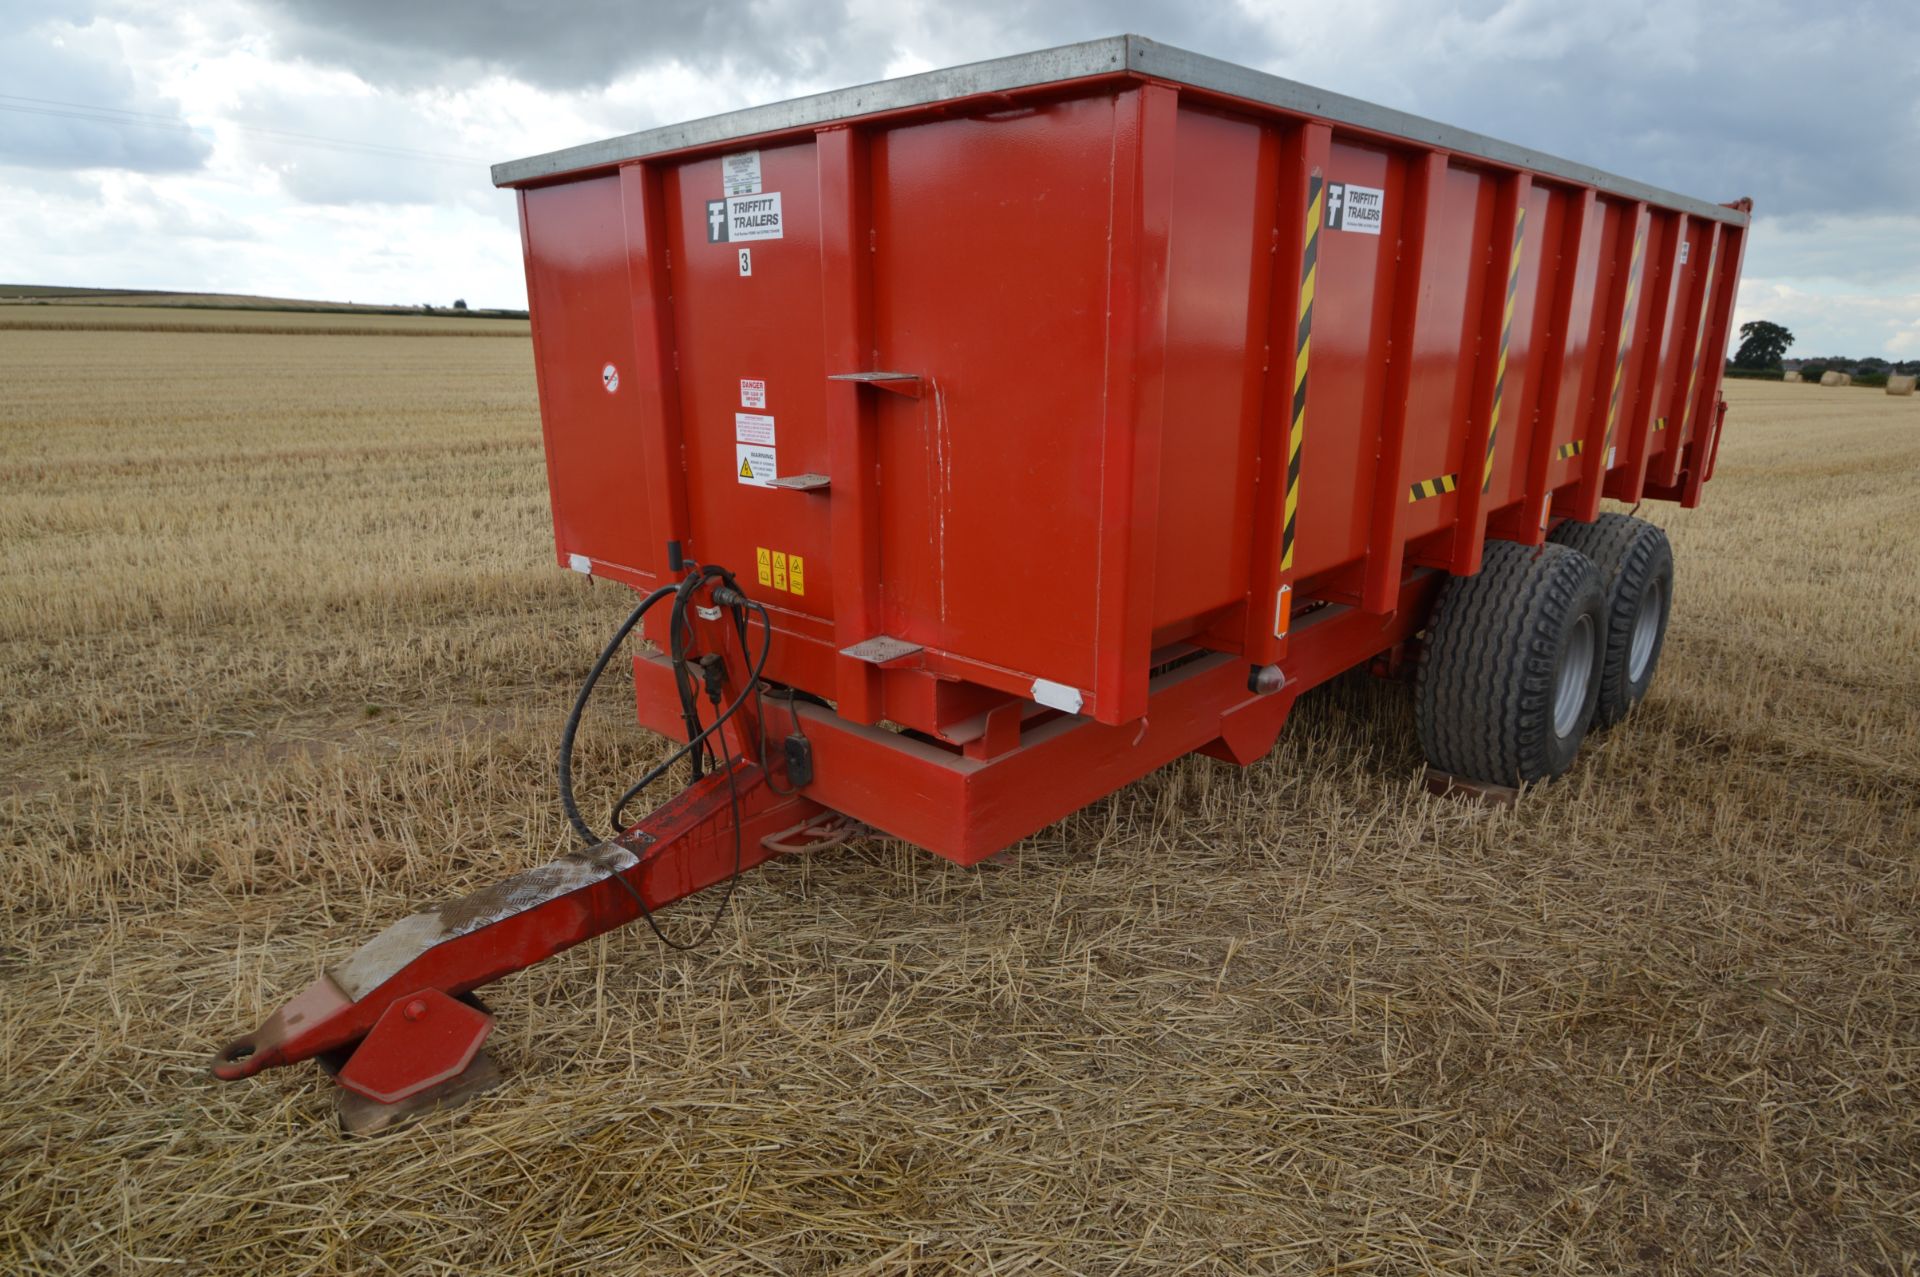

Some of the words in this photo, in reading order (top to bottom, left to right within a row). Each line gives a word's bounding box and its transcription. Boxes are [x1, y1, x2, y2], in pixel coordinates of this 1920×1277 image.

[1348, 190, 1379, 207] TRIFFITT
[733, 199, 774, 215] TRIFFITT
[1347, 206, 1380, 222] TRAILERS
[734, 213, 779, 229] TRAILERS
[741, 252, 749, 272] 3
[742, 381, 764, 389] DANGER
[750, 452, 774, 460] WARNING
